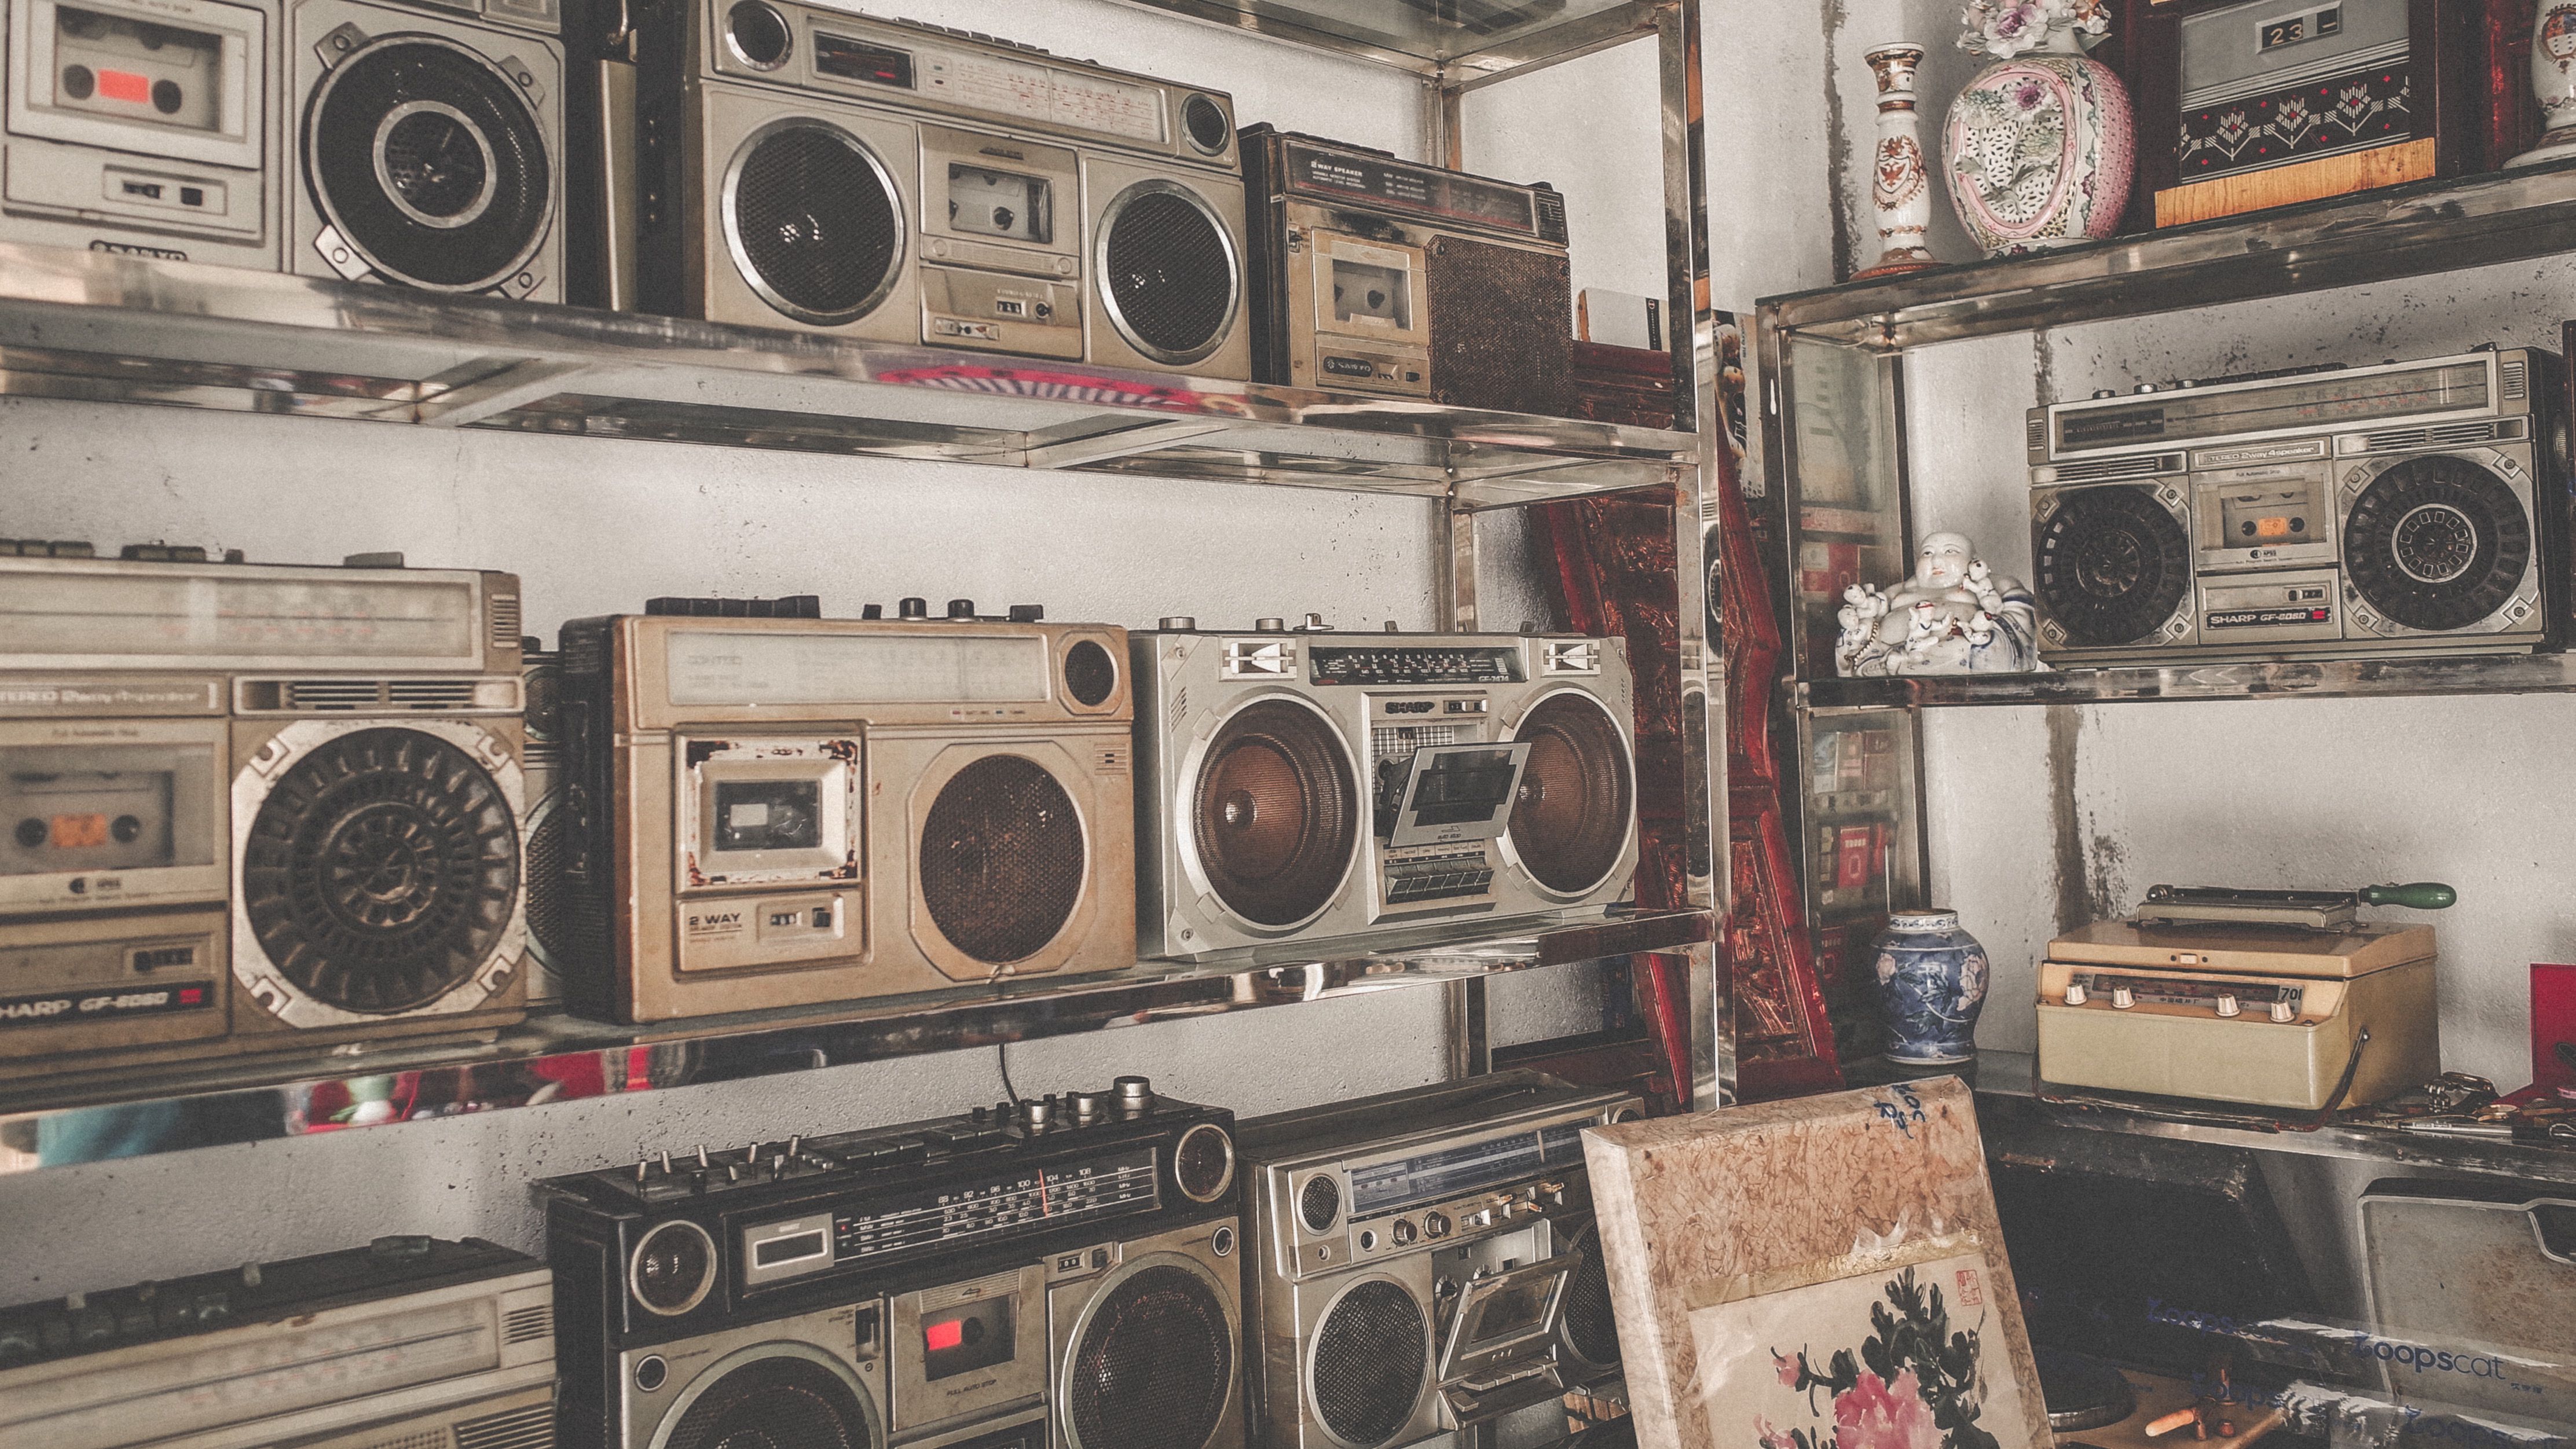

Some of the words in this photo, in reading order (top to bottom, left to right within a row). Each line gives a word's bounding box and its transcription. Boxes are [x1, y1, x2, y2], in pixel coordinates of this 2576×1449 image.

[2270, 23, 2303, 45] 23
[1334, 167, 1363, 177] SPEAKER
[2211, 615, 2256, 624] SHARP
[1385, 701, 1435, 714] SHARP
[705, 912, 741, 925] WAY
[2281, 987, 2303, 1001] 701
[0, 999, 72, 1019] HARP
[937, 1195, 949, 1204] 88
[963, 1190, 974, 1199] 92
[990, 1185, 1001, 1194] 96
[1017, 1179, 1031, 1188] 100
[1046, 1174, 1059, 1183] 104
[1078, 1167, 1091, 1176] 108
